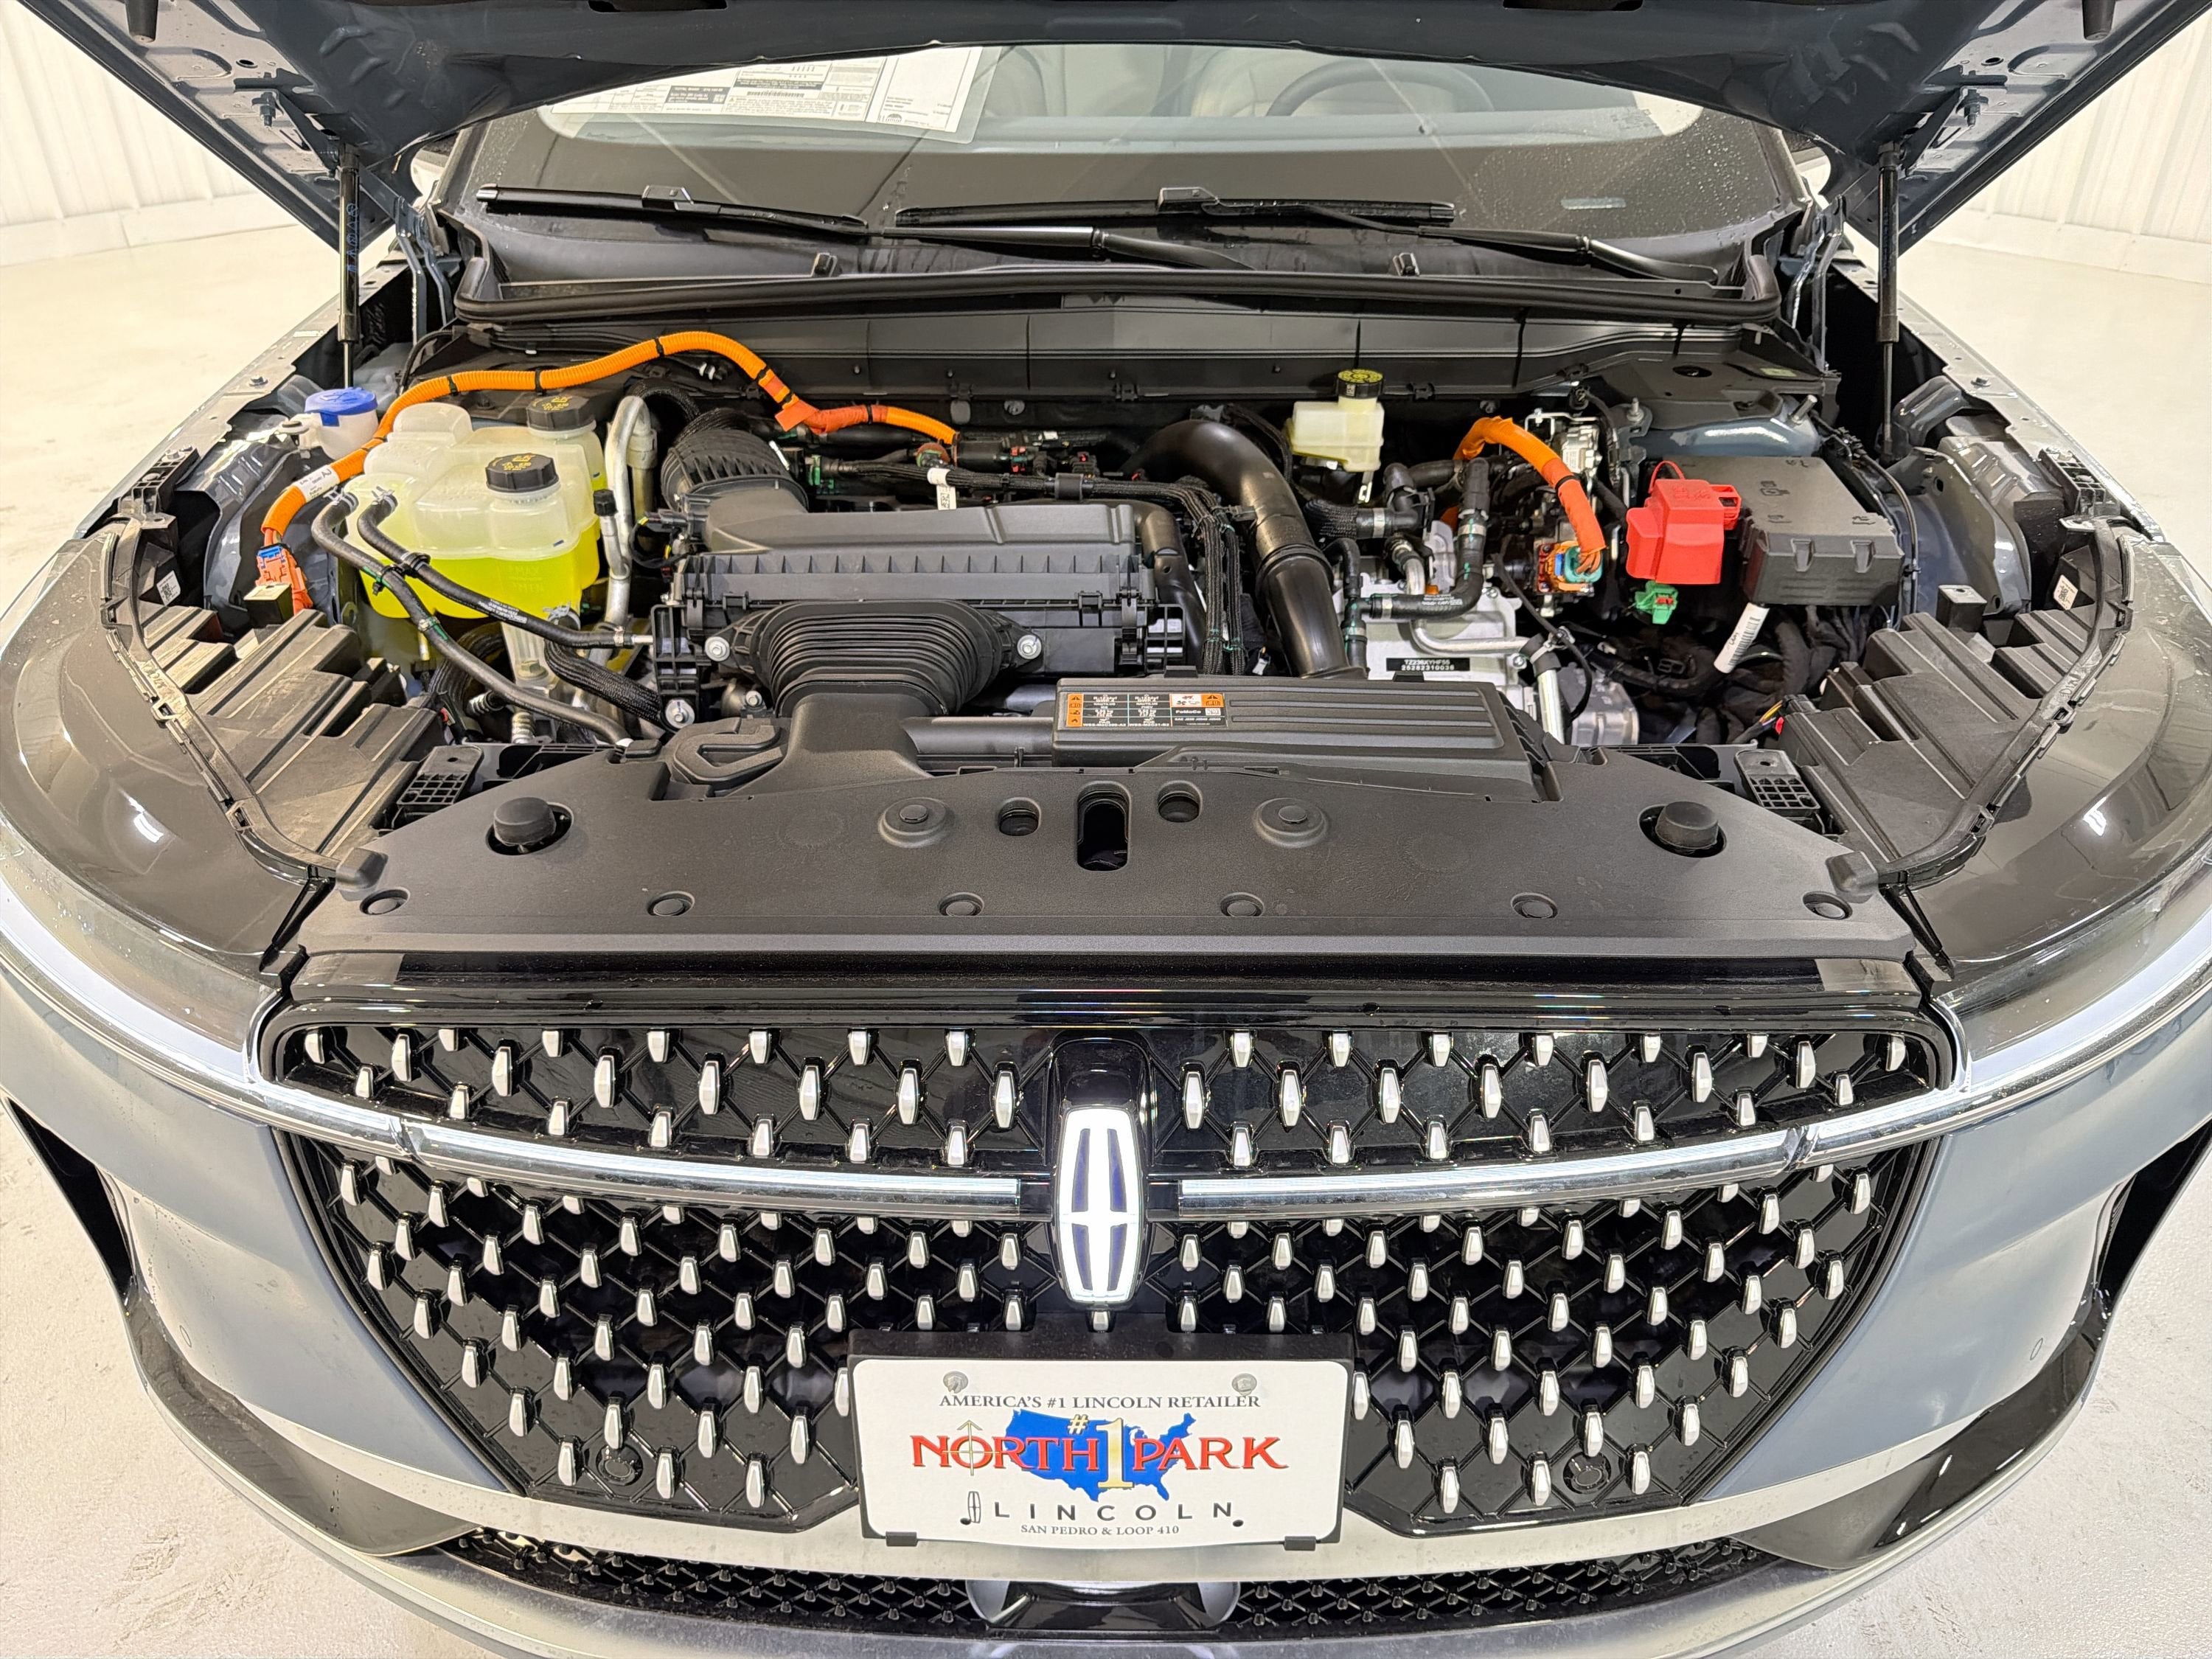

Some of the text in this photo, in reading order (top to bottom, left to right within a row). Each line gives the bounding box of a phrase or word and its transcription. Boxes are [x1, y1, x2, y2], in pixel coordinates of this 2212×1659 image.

[939, 1394, 1261, 1409] AMERICA'S #1 LINCOLN RETAILER
[911, 1434, 1099, 1472] NORTH
[1133, 1436, 1290, 1471] PARK
[994, 1501, 1232, 1522] LINCOLN
[1020, 1524, 1179, 1536] SAN PEDRO & LOOP 410
